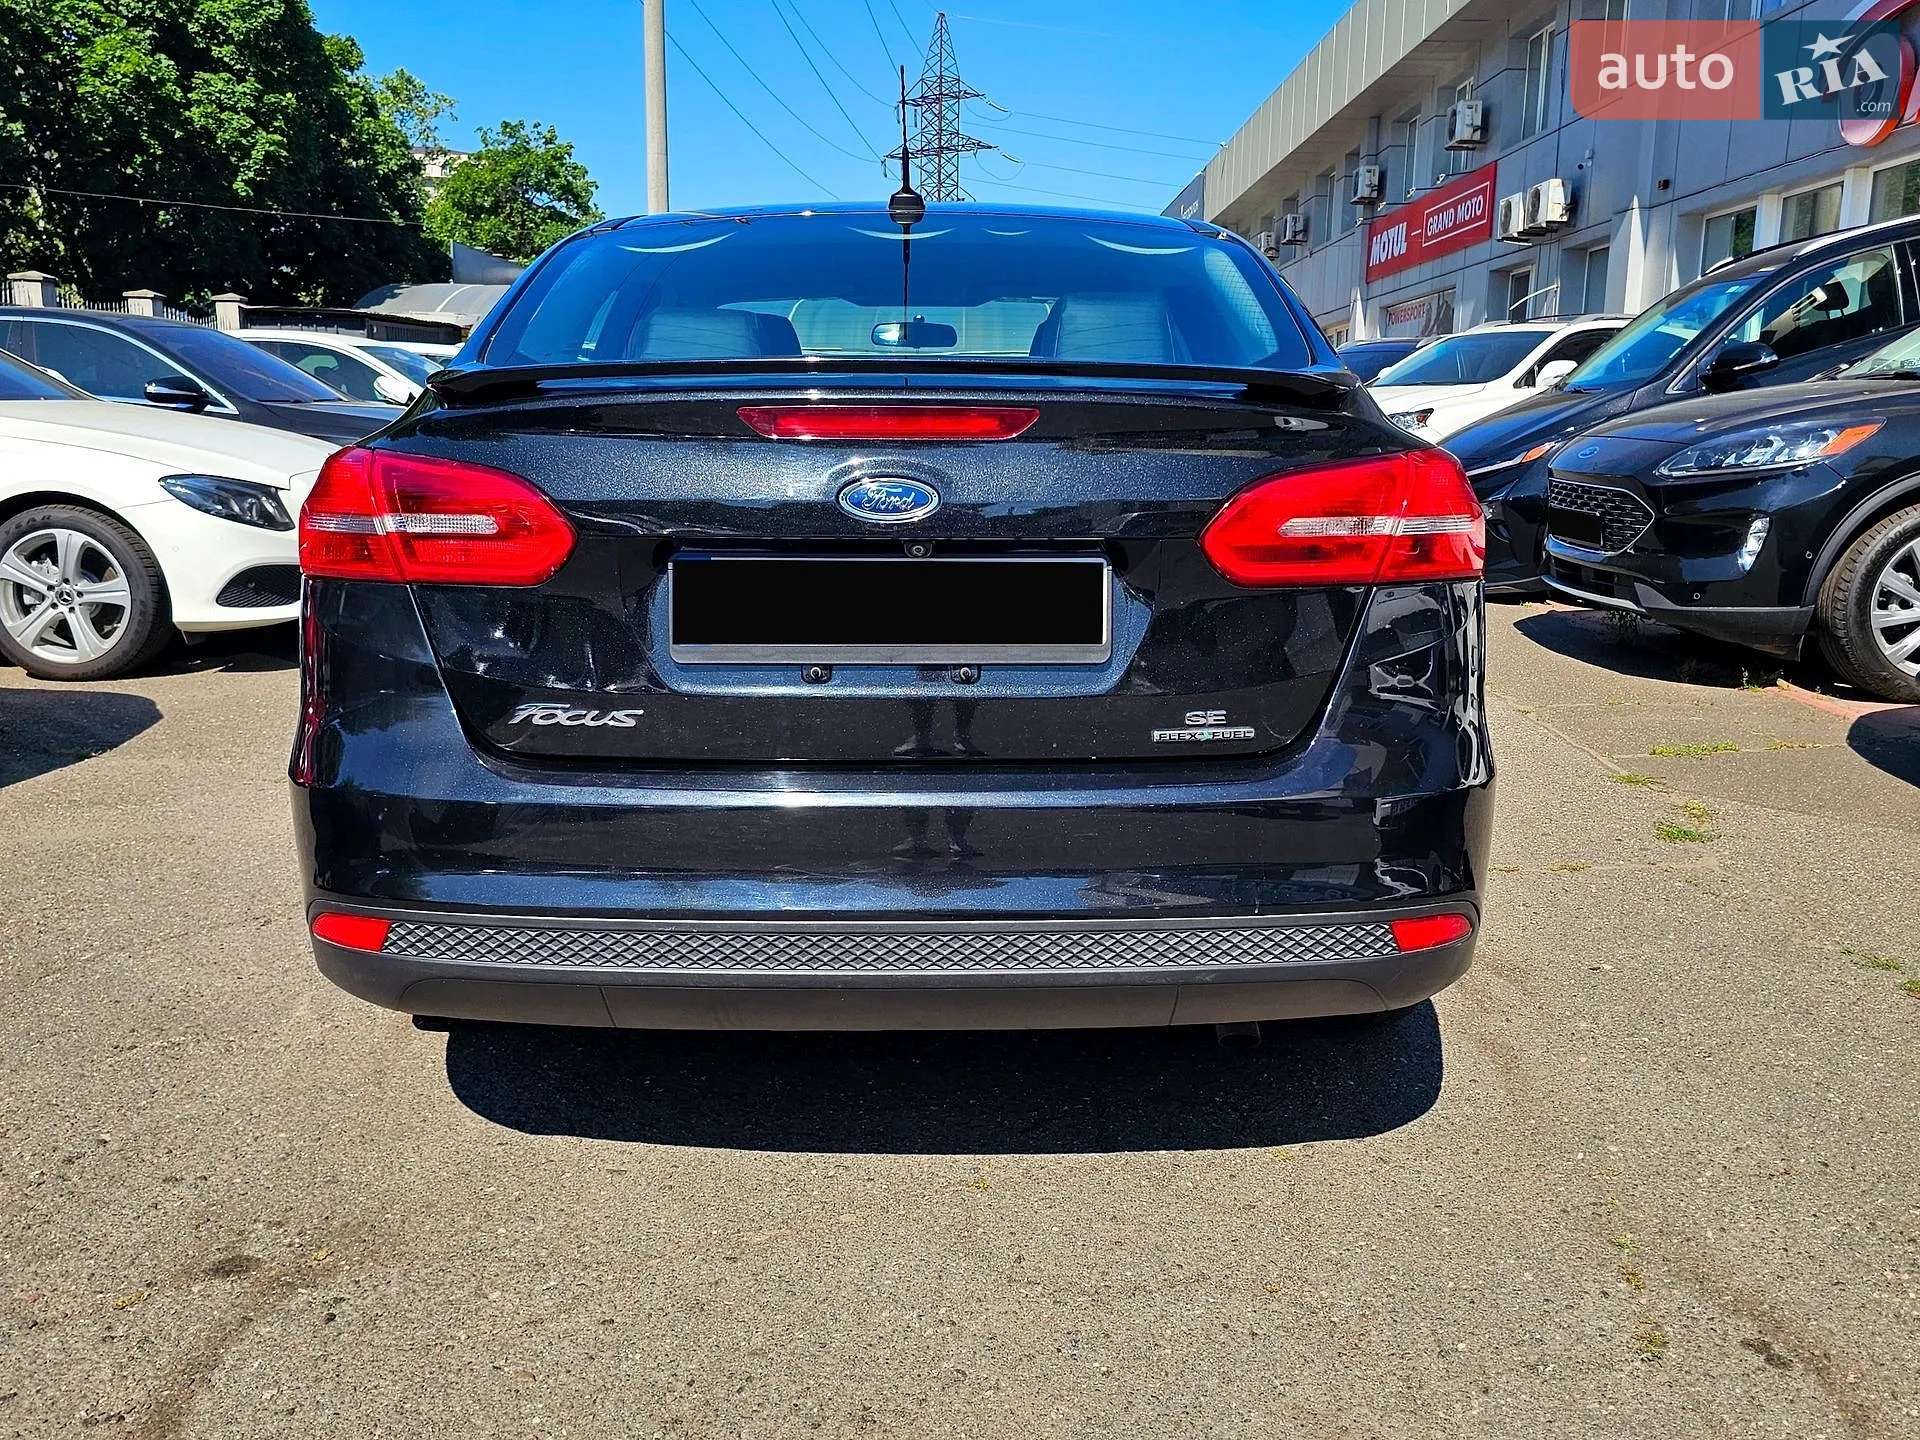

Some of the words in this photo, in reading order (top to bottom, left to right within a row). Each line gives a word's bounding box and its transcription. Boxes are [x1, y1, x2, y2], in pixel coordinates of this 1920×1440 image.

[1369, 222, 1408, 267] MOTUL
[1427, 208, 1455, 237] GRAND
[1456, 194, 1484, 223] MOTO
[861, 486, 915, 510] Ford
[1185, 709, 1227, 726] SE
[1159, 732, 1199, 741] FLEX
[1212, 730, 1252, 739] FUEL
